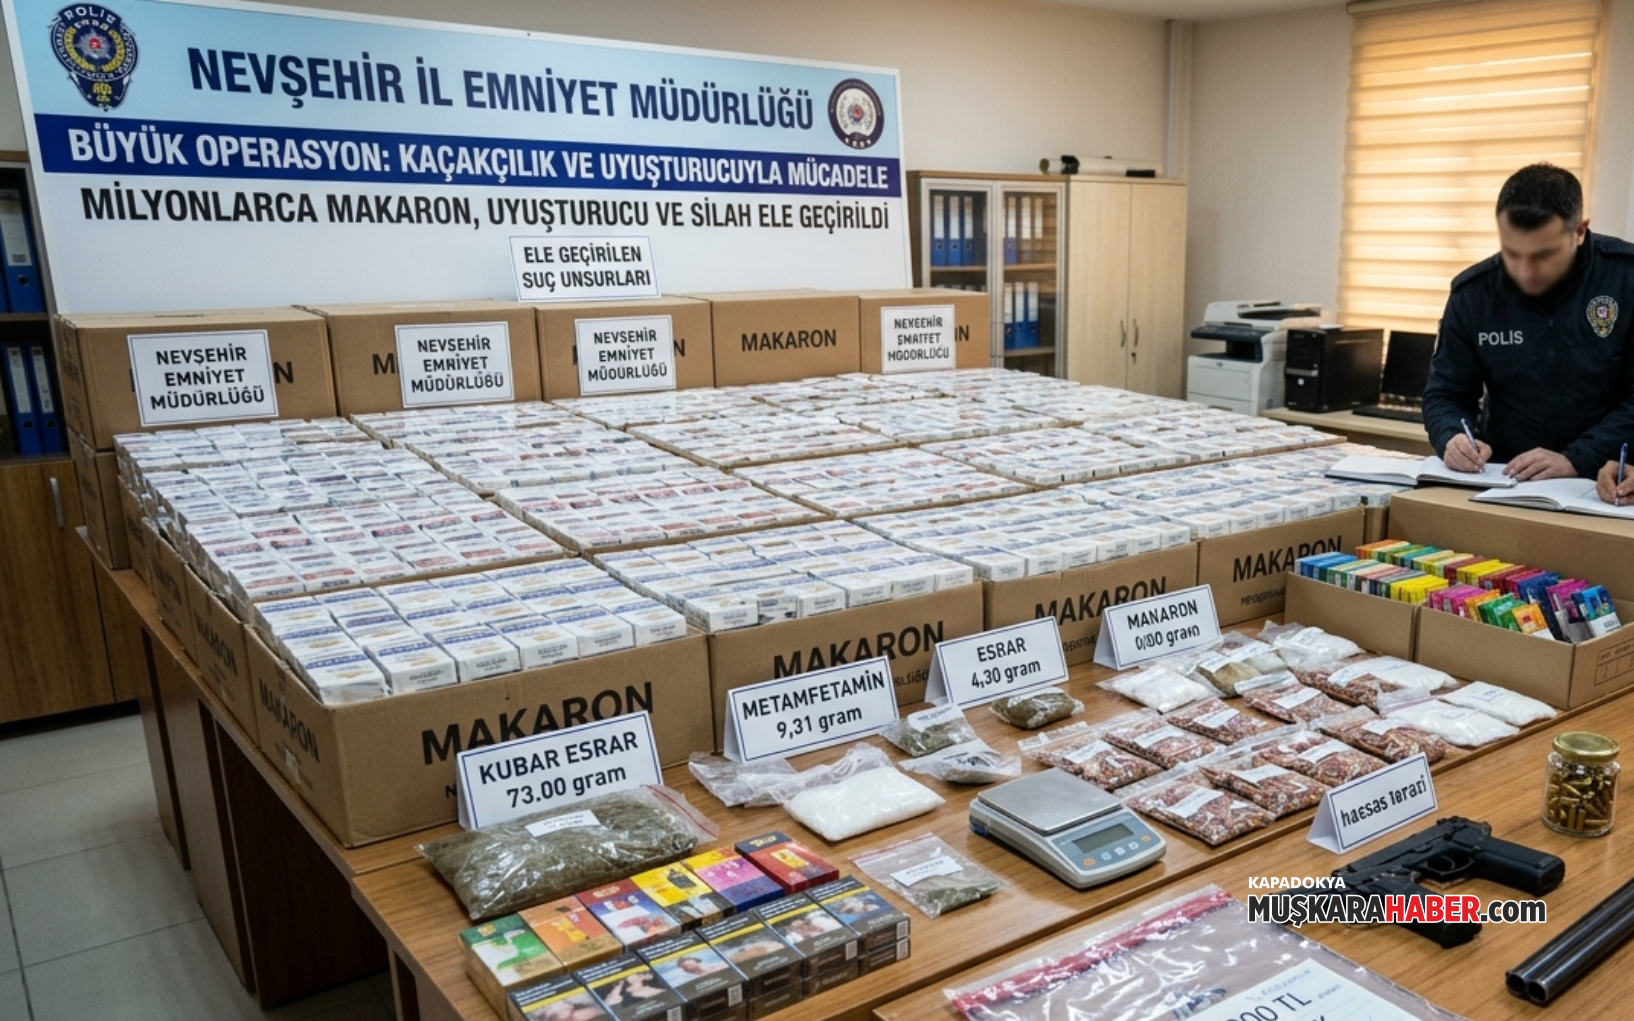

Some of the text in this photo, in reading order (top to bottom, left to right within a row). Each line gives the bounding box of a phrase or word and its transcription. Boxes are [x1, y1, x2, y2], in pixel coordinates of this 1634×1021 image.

[187, 47, 405, 109] NEVŞEHİR
[416, 56, 453, 108] İL
[463, 67, 618, 117] EMNİYET
[630, 77, 814, 130] MÜDÜRLÜĞÜ
[68, 122, 889, 189] BÜYÜK OPERASYON: KAÇAKÇILIK VE UYUŞTURUCUYLA MÜCADELE
[81, 181, 890, 234] MİLYONLARCA MAKARON, UYUŞTURUCU VE SİLAH ELE GEÇİRİLDİ
[523, 242, 642, 265] ELE GEÇİRİLEN
[522, 269, 651, 292] SUÇ UNSURLARI
[741, 329, 837, 352] MAKARON
[1478, 330, 1524, 346] POLIS
[156, 343, 247, 366] NEVŞEHİR
[598, 344, 655, 362] EMNİYET
[165, 366, 245, 387] EMNİYET
[150, 385, 265, 410] MÜDÜRLÜĞÜ
[774, 620, 943, 679] MAKARON
[971, 660, 1041, 689] 4,30 gram
[741, 669, 886, 720] METAMFETAMİN
[421, 681, 653, 765] MAKARON
[776, 705, 863, 740] 9,31 gram
[479, 731, 638, 785] KUBAR ESRAR
[506, 766, 627, 809] 73.00 gram
[1271, 992, 1312, 1012] TL
